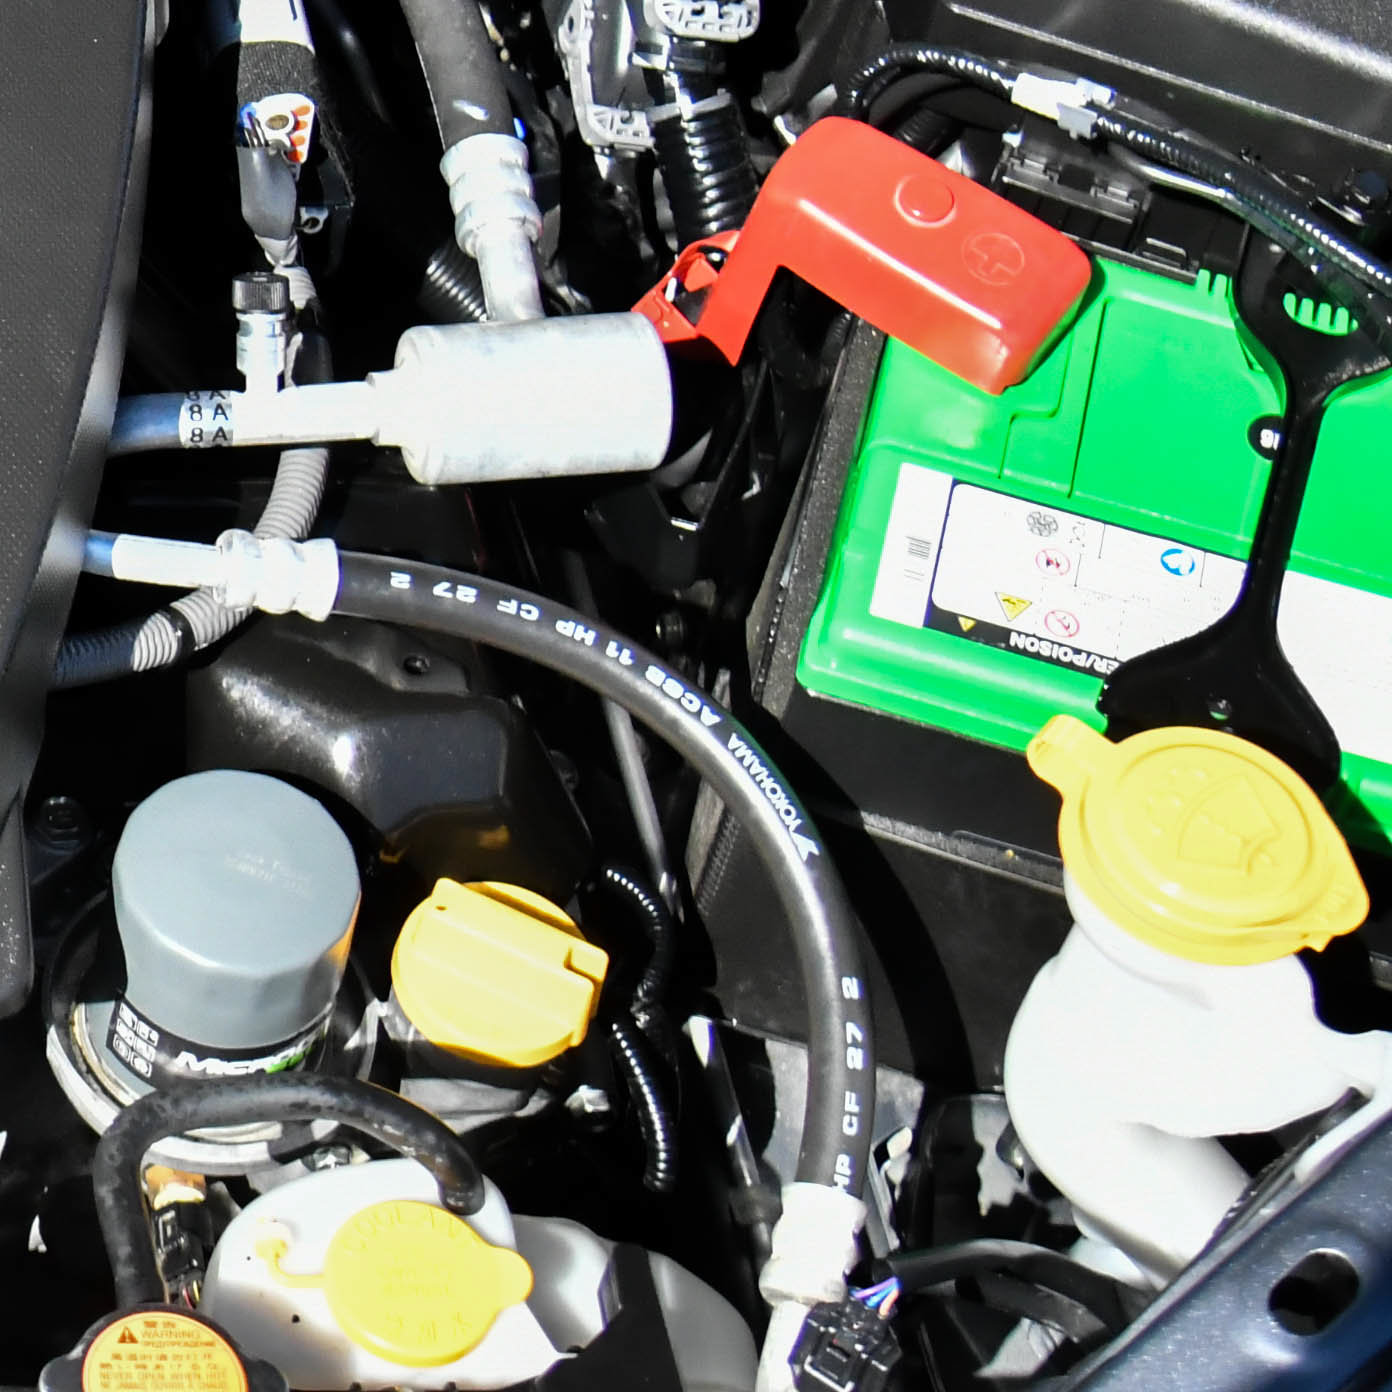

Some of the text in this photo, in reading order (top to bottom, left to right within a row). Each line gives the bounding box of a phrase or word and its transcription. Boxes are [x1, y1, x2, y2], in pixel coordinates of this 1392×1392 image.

[189, 403, 229, 421] 8 A
[190, 426, 228, 443] 8 A
[390, 571, 412, 589] 2
[432, 581, 478, 604] 27
[496, 599, 540, 622] CF
[555, 619, 596, 646] HP
[727, 731, 803, 832] YOKOHAMA
[841, 976, 860, 1000] 2
[845, 1021, 864, 1070] 27
[843, 1091, 860, 1136] CF
